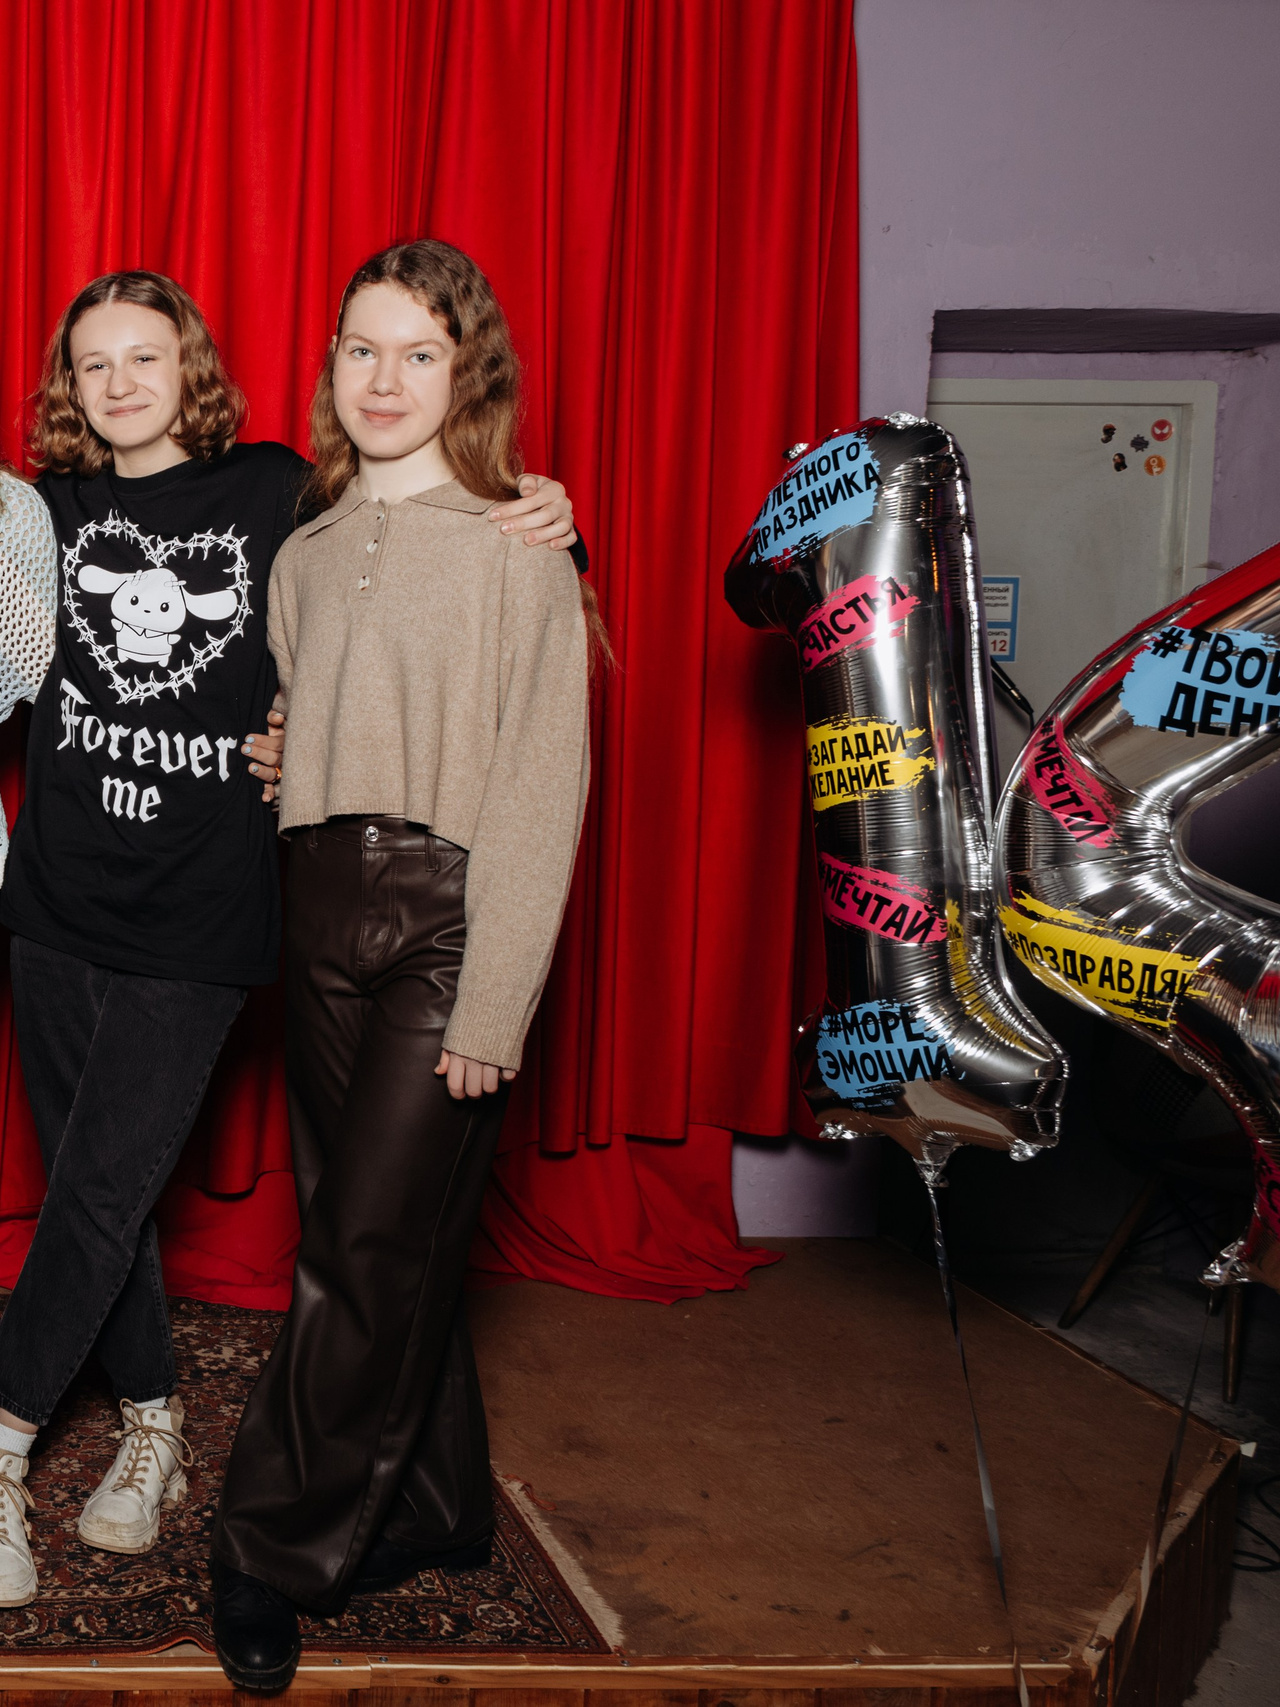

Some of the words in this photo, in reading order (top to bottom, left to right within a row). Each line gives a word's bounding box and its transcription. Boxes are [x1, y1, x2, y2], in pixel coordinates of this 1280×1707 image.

[57, 677, 238, 782] Forever
[101, 775, 162, 823] me
[810, 760, 895, 799] ЖЕЛАНИЕ
